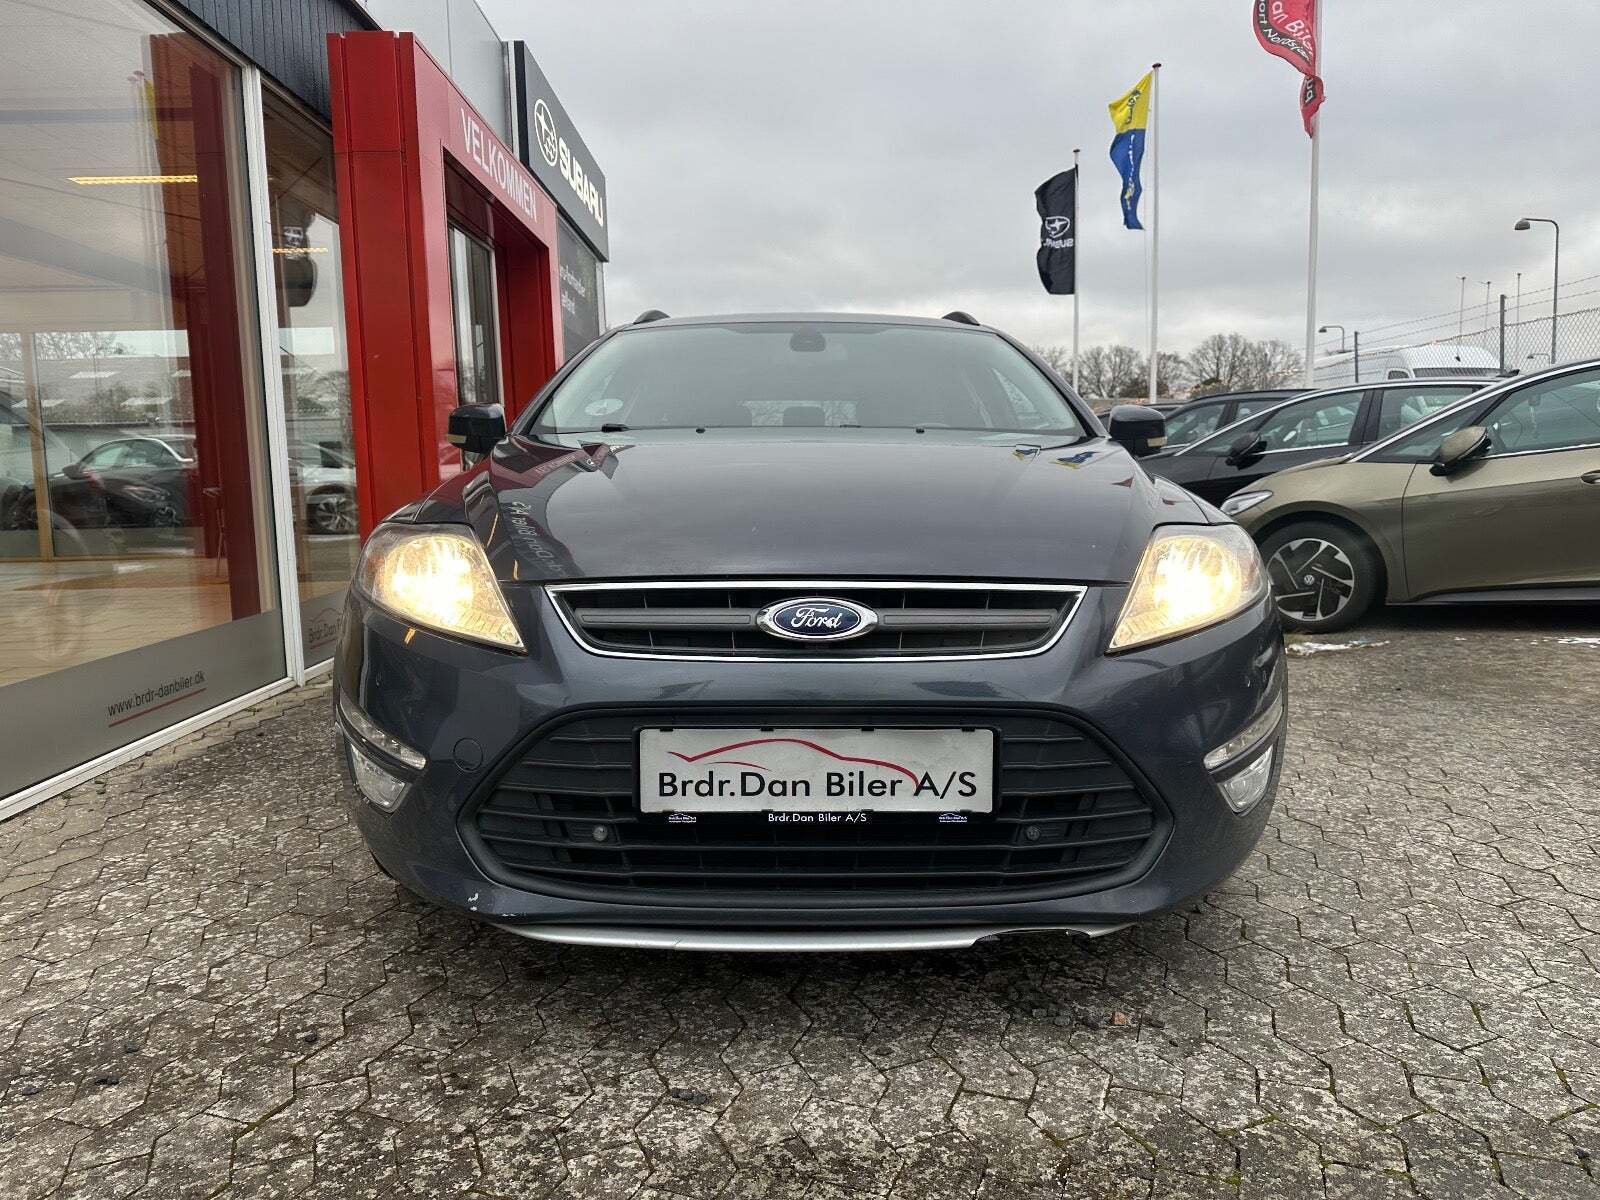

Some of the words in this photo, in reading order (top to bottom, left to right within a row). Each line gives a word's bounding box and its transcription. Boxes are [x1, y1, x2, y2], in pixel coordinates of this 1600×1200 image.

[1258, 0, 1267, 24] ort
[1271, 1, 1288, 23] an
[461, 106, 538, 222] VELKOMMEN
[559, 136, 604, 227] SUBARU
[790, 607, 842, 628] Ford
[107, 670, 206, 717] www.brdr-danbiler.dk
[658, 770, 811, 797] Brdr.Dan
[826, 770, 903, 797] Biler
[913, 770, 977, 800] A/S
[768, 812, 814, 822] Brdr.Dan
[819, 812, 842, 822] Biler
[845, 812, 867, 823] A/S
